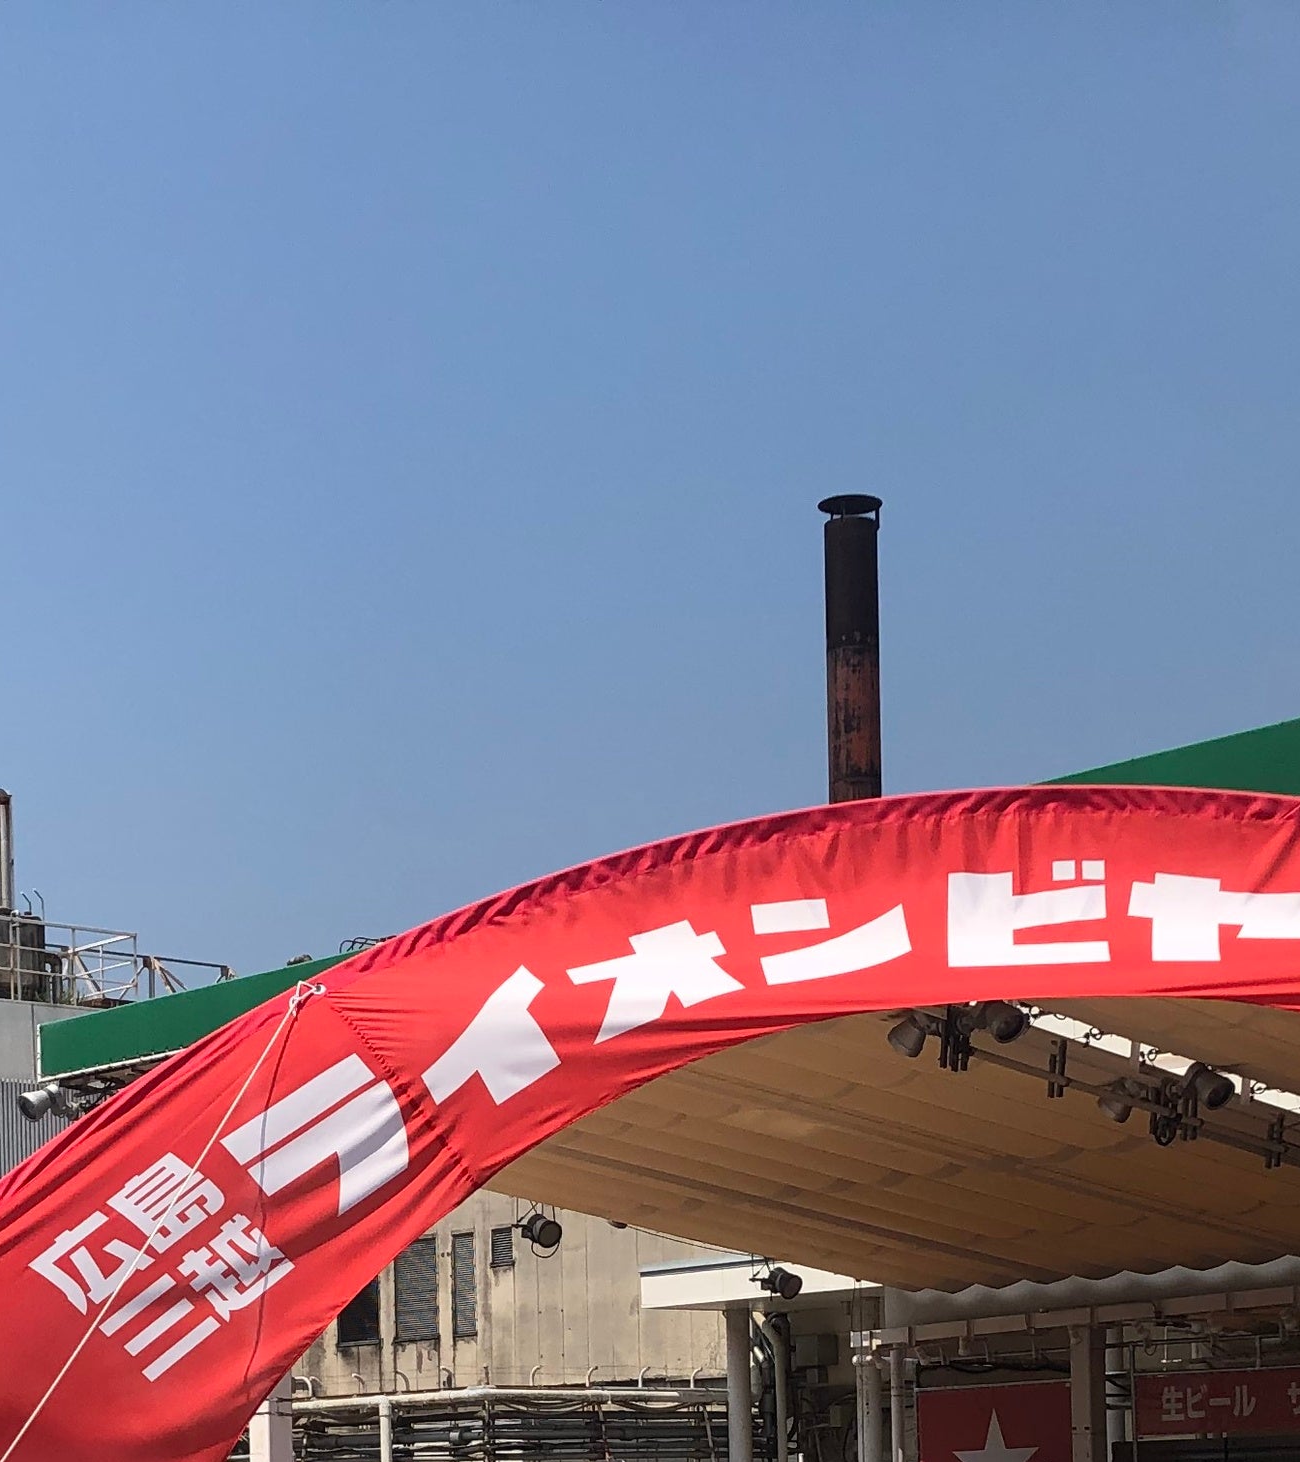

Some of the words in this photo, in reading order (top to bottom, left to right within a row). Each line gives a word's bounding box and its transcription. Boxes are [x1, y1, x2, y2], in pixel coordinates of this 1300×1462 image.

[27, 1151, 226, 1316] 広島
[98, 1212, 296, 1383] 三越
[1160, 1382, 1256, 1424] 生ビール
